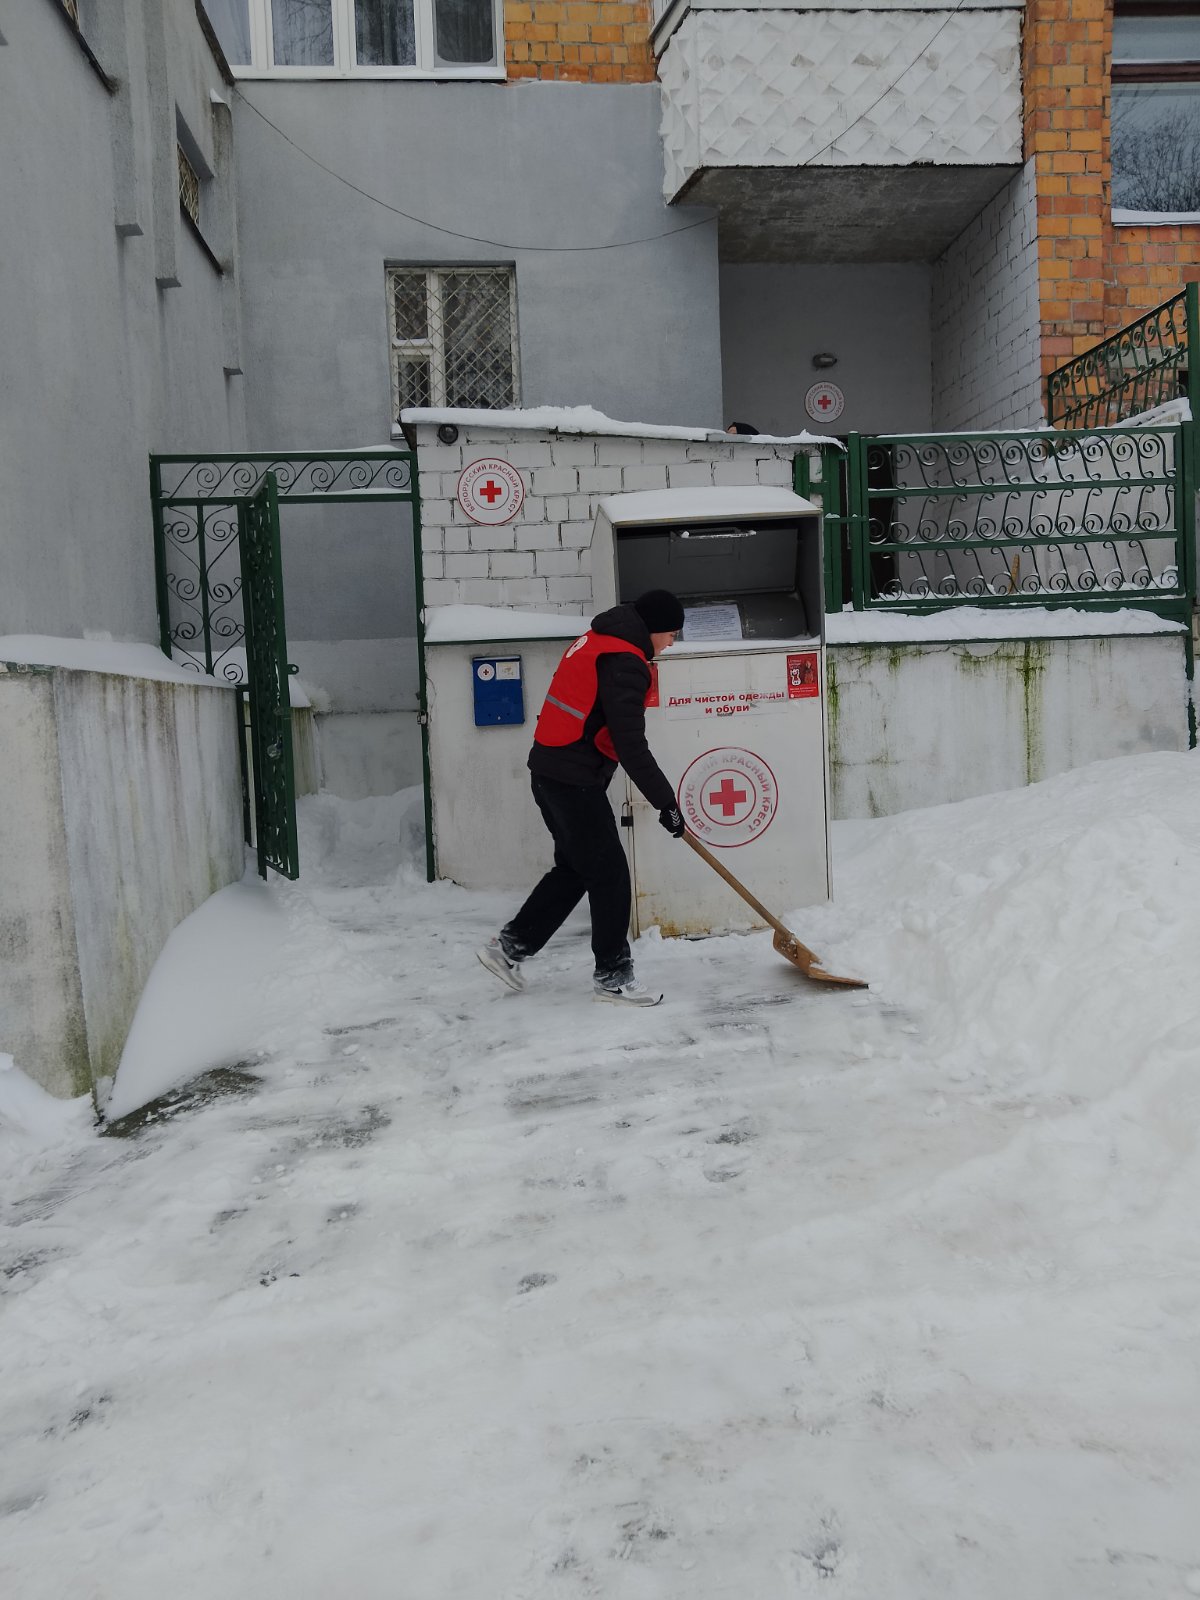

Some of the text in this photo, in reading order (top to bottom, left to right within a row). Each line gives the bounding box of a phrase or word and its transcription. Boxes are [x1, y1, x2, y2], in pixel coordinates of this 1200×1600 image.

[462, 463, 520, 513] БЕЛОРУССКИЙ КРАСНЫЙ КРЕСТ
[668, 697, 691, 706] Для
[695, 693, 735, 703] чистой
[739, 691, 785, 702] одежды
[705, 706, 712, 714] и
[716, 704, 750, 715] обуви
[721, 754, 771, 792] КРАСНЫЙ
[747, 796, 772, 833] КРЕСТ
